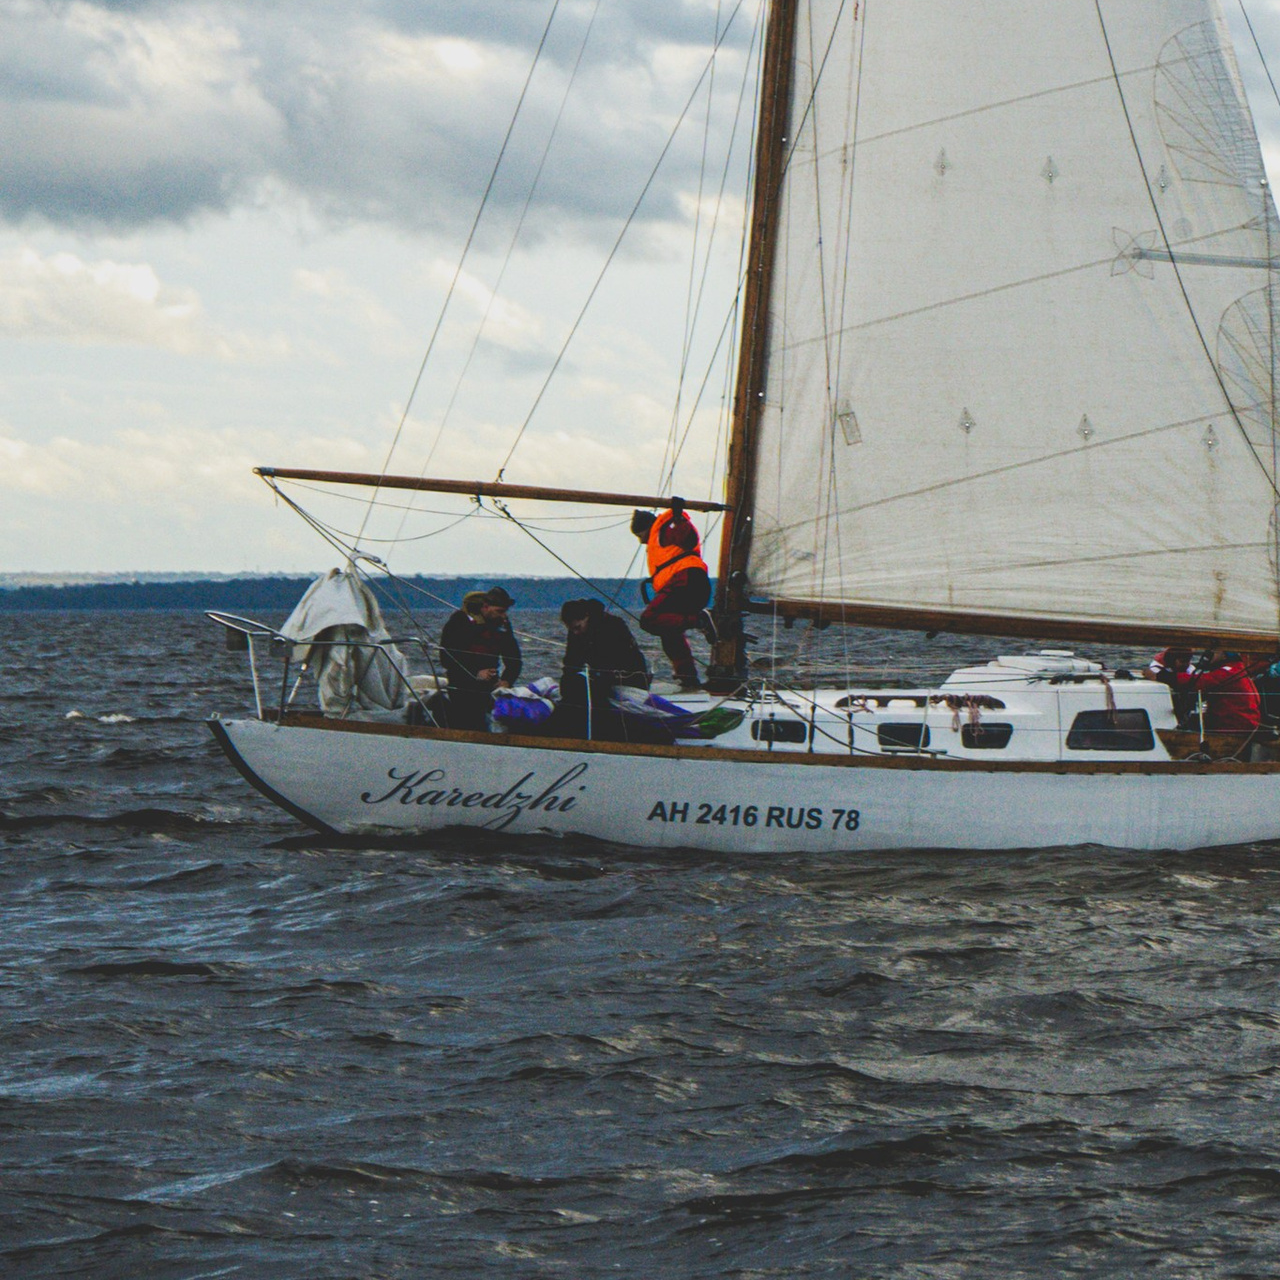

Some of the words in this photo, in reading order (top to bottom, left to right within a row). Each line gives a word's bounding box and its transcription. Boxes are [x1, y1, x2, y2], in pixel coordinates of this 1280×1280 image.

[360, 762, 589, 831] Karedzhi
[647, 800, 690, 823] AH
[696, 803, 759, 827] 2416
[765, 806, 823, 830] RUS
[831, 809, 861, 831] 78
